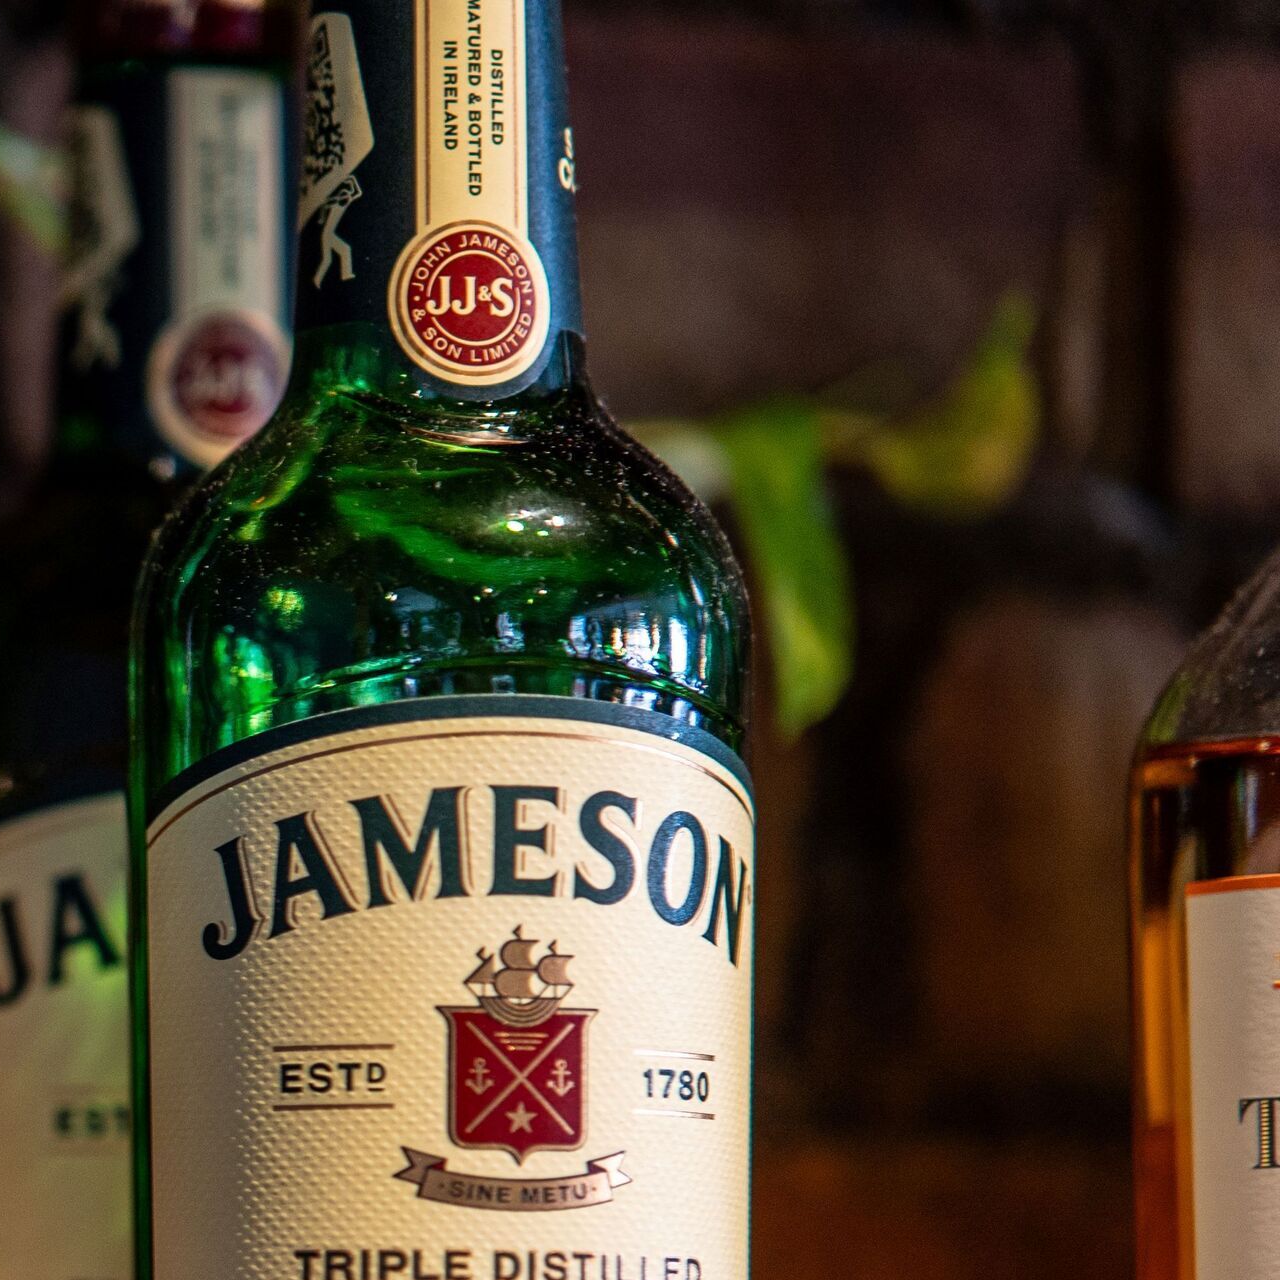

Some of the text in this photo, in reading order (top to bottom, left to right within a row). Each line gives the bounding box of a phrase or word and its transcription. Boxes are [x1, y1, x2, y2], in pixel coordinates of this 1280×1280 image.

[443, 40, 458, 151] IN IRELAND
[467, 0, 482, 197] MATURED & BOTTLED
[490, 48, 504, 146] DISTILLED
[412, 233, 533, 294] JOHN JAMESON
[425, 275, 515, 318] JJ&S
[412, 308, 532, 363] & SON LIMITED
[202, 784, 747, 968] JAMESON
[279, 1061, 387, 1094] ESTD
[643, 1068, 709, 1103] 1780
[449, 1180, 588, 1205] SINE METU
